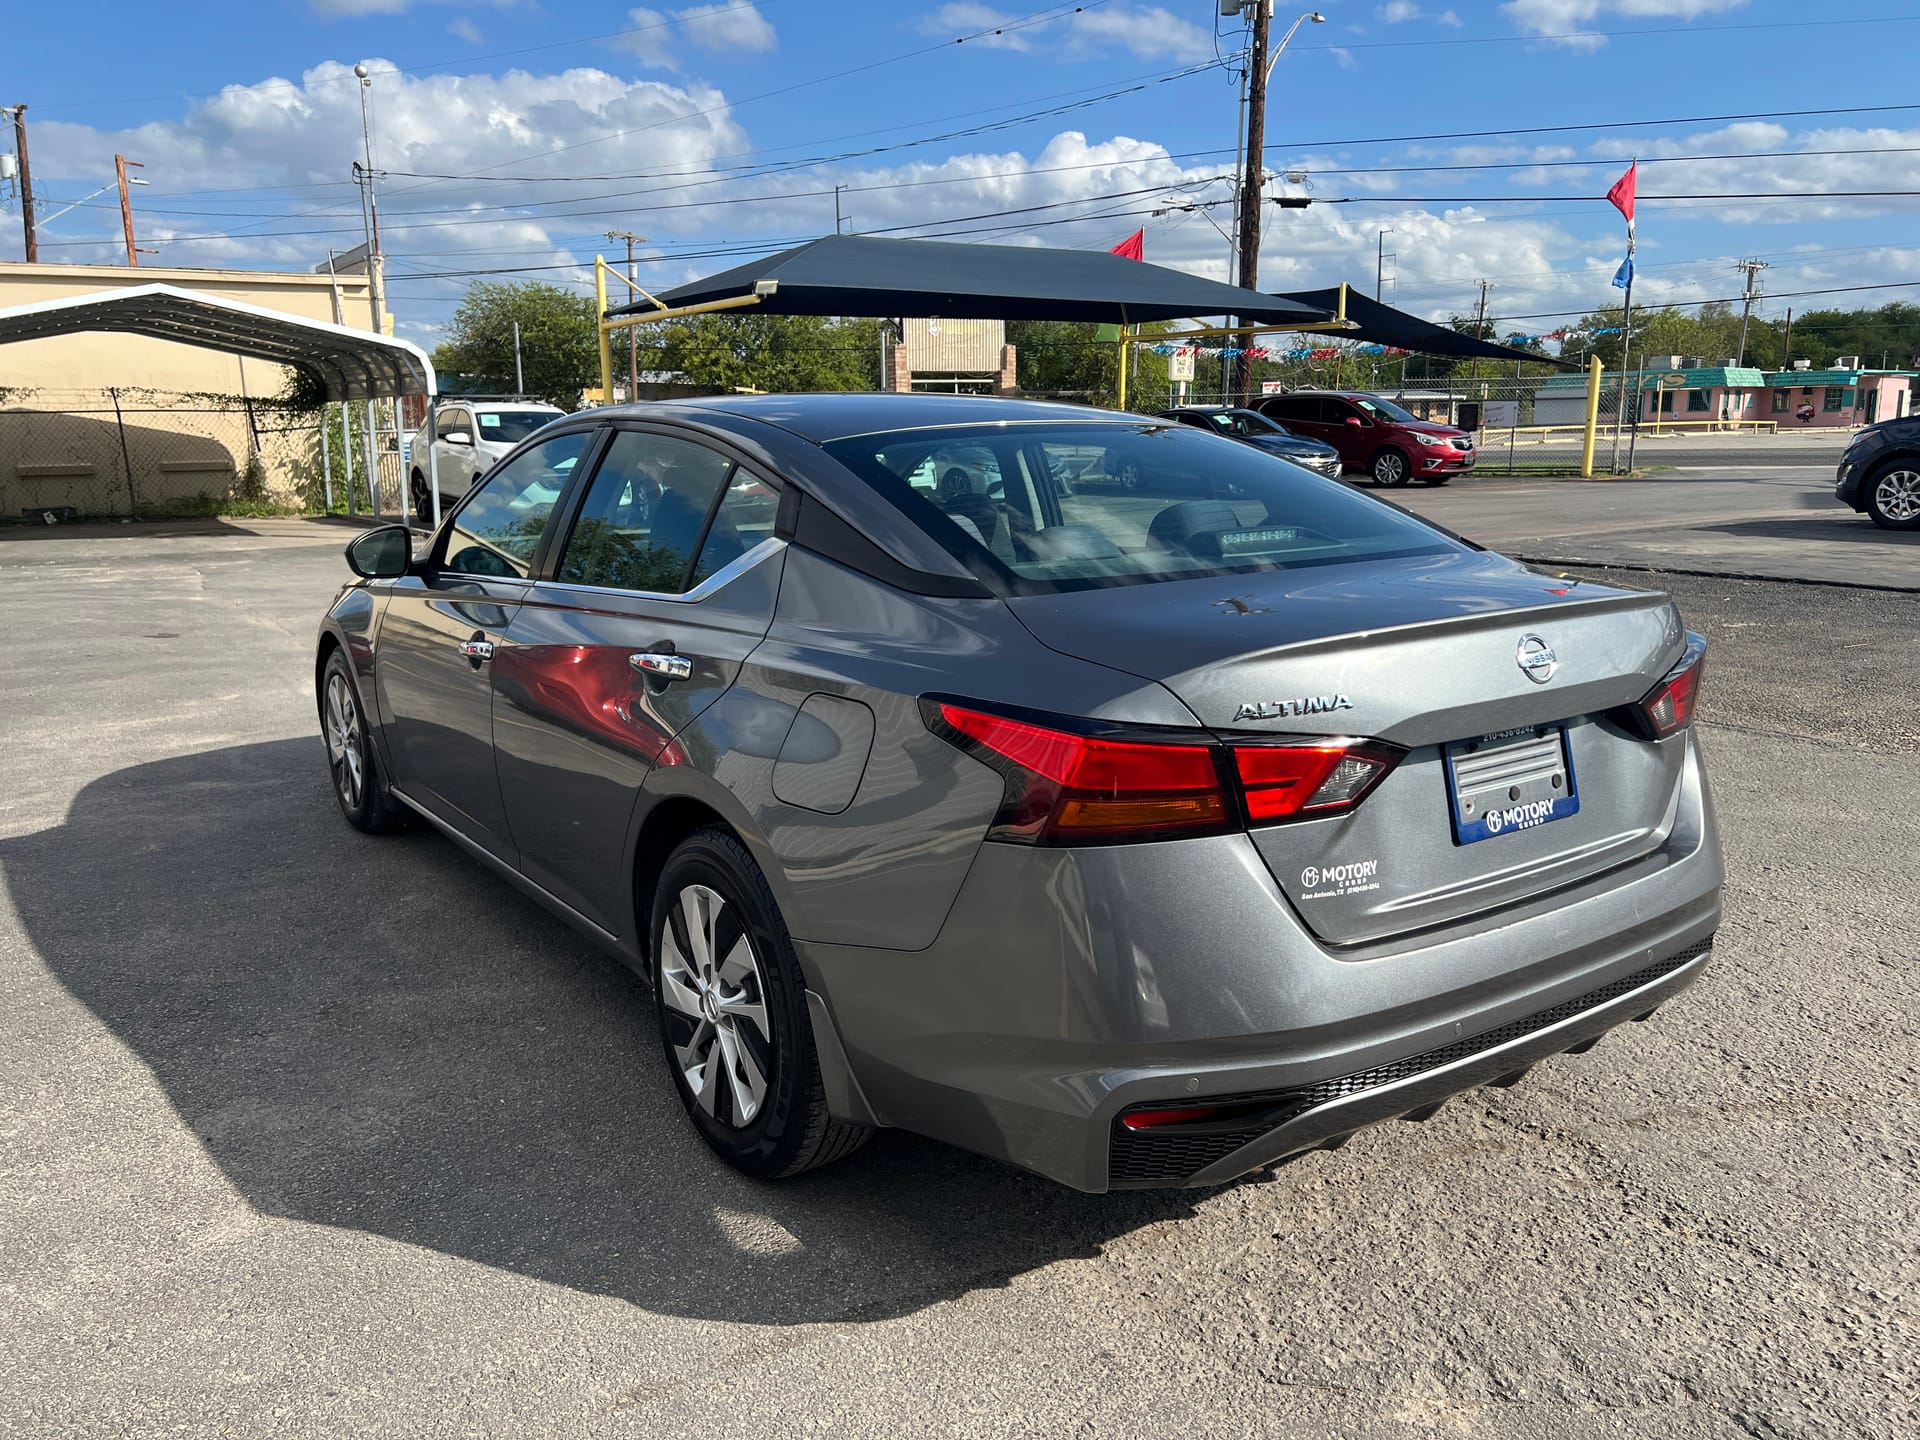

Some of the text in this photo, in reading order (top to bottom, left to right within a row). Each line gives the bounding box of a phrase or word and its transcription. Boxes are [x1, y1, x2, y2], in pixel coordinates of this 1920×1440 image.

[1524, 651, 1554, 665] NISSAN
[1232, 694, 1354, 722] ALTIMA
[1503, 798, 1555, 826] MOTORY
[1518, 817, 1545, 829] GROUP
[1322, 859, 1378, 883] MOTORY
[1338, 877, 1367, 888] GROUP
